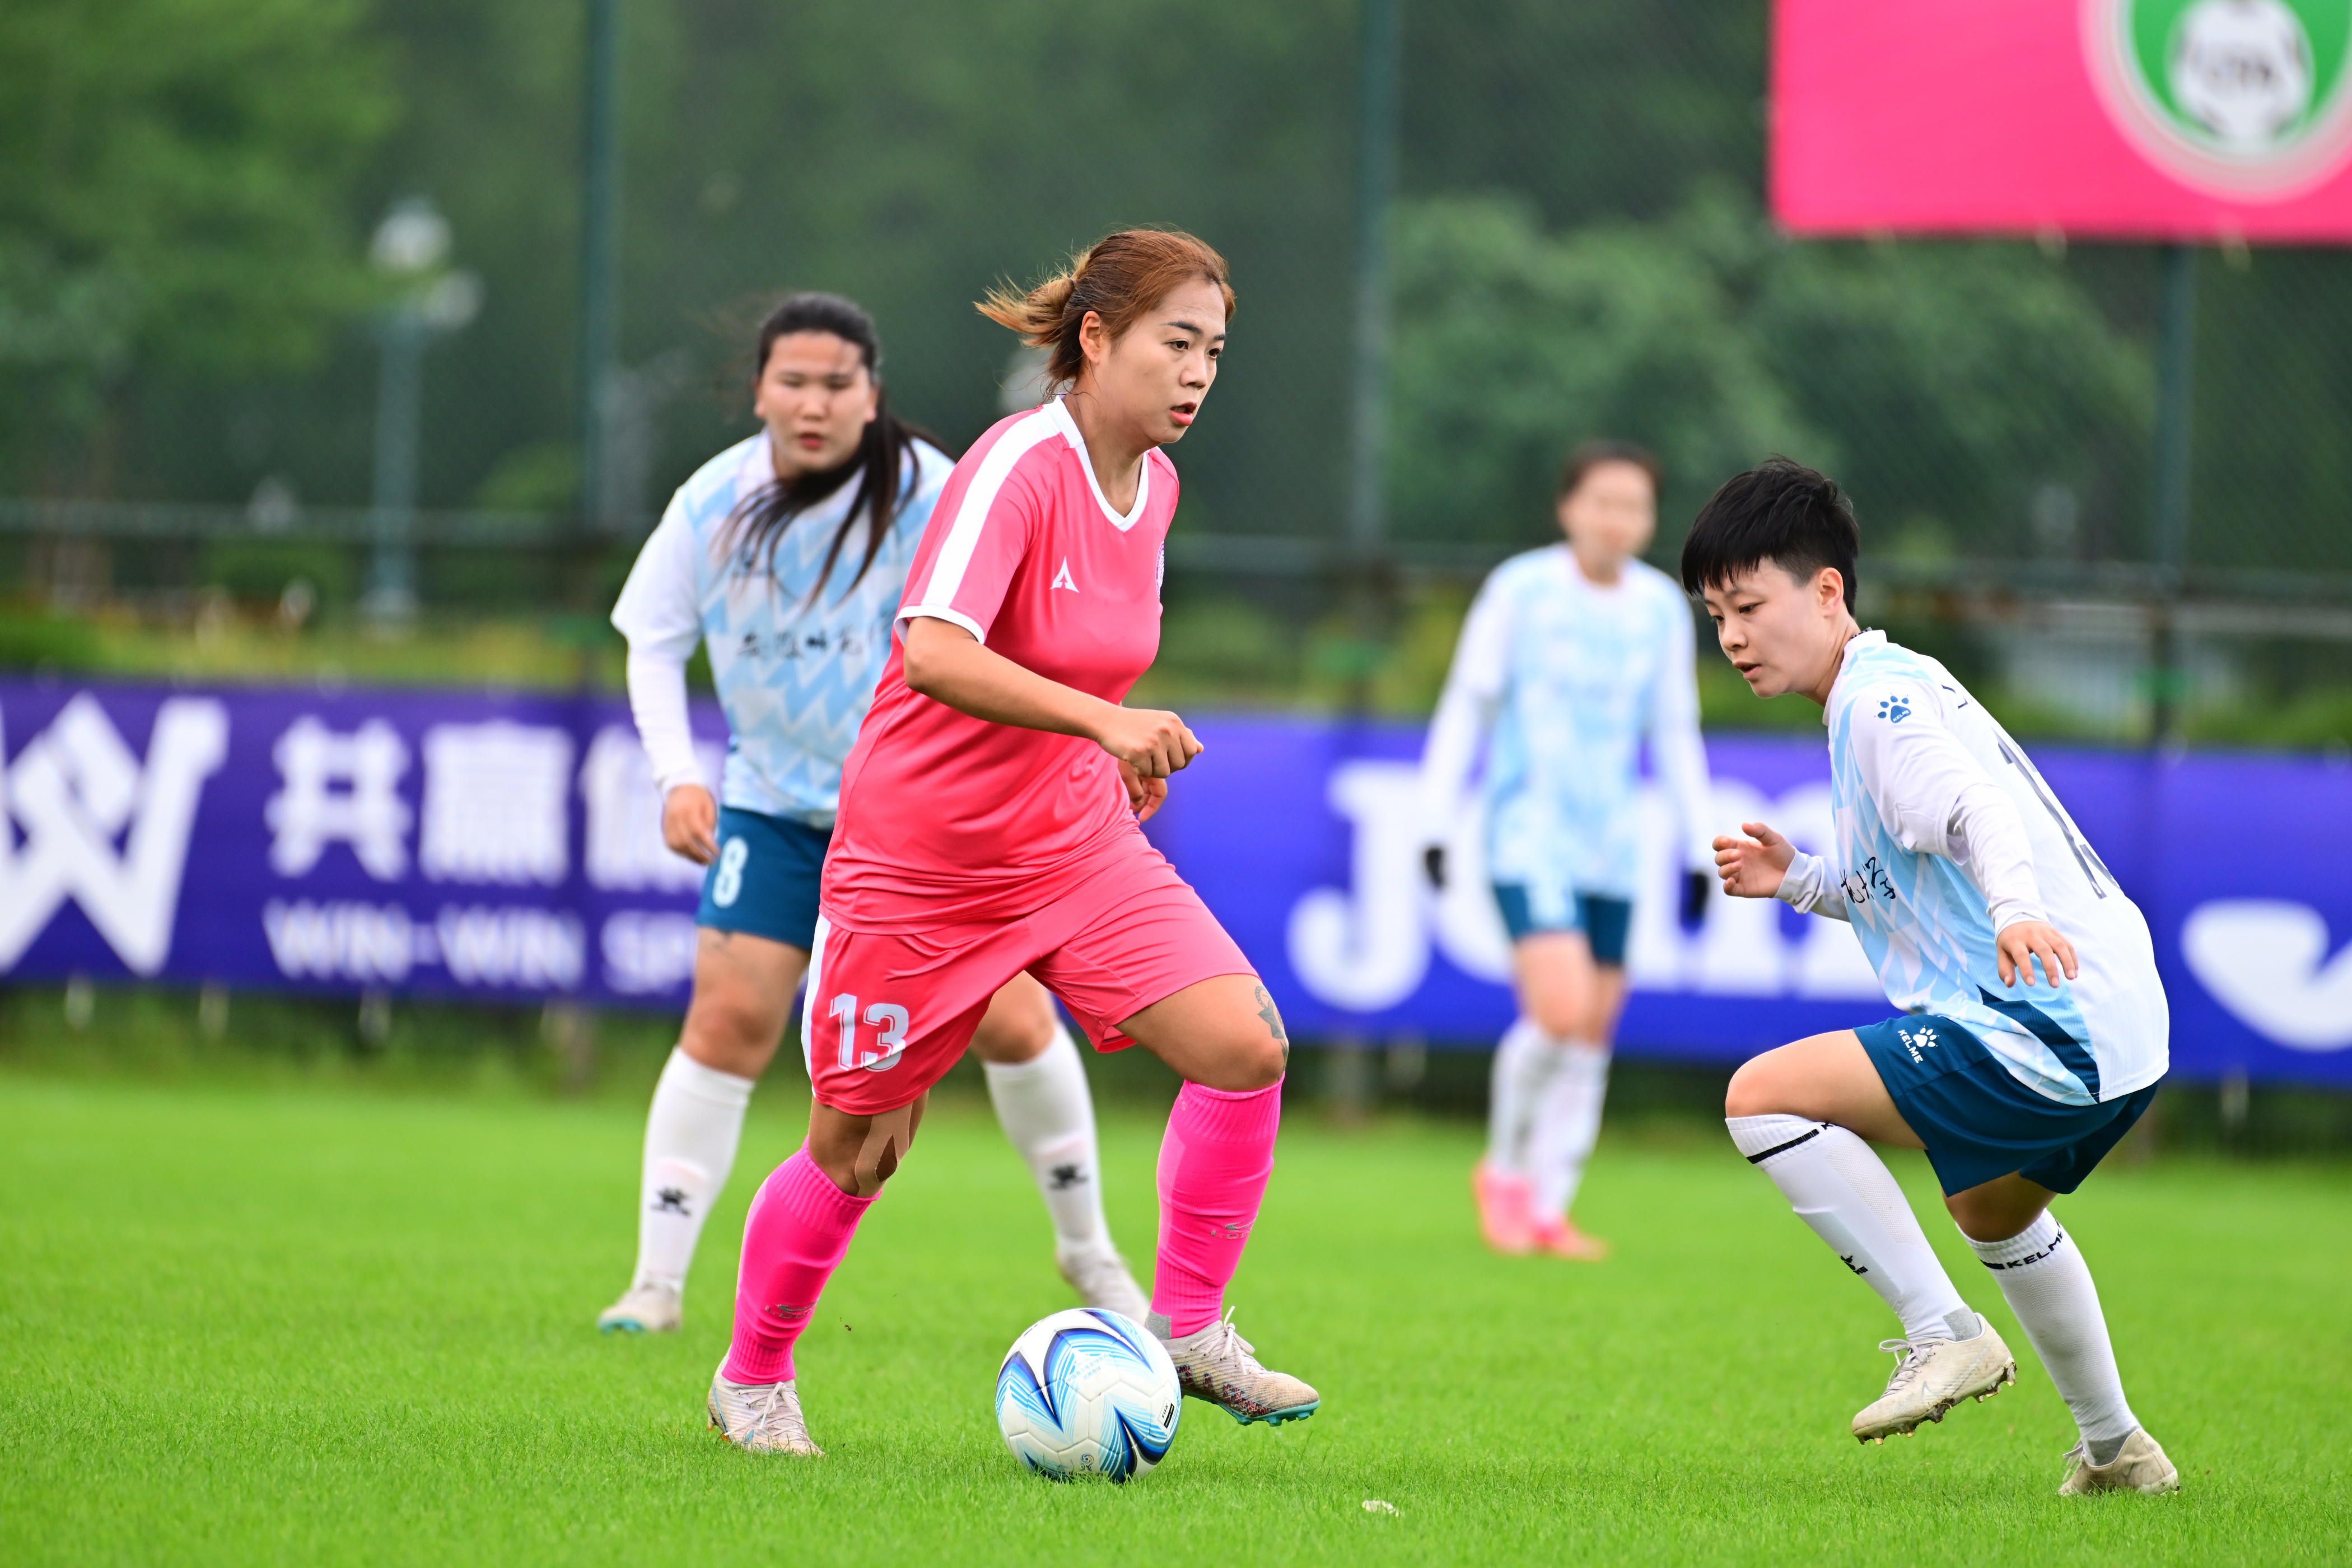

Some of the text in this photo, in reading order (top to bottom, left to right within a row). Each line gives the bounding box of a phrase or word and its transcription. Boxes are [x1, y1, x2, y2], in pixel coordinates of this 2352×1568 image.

[1893, 710, 1910, 722] KELME
[1991, 727, 2122, 900] 1
[713, 836, 748, 908] 8
[263, 899, 585, 990] WIN-WIN
[828, 992, 909, 1072] 13
[1898, 1029, 1924, 1064] KELME
[2006, 1228, 2063, 1268] KELME
